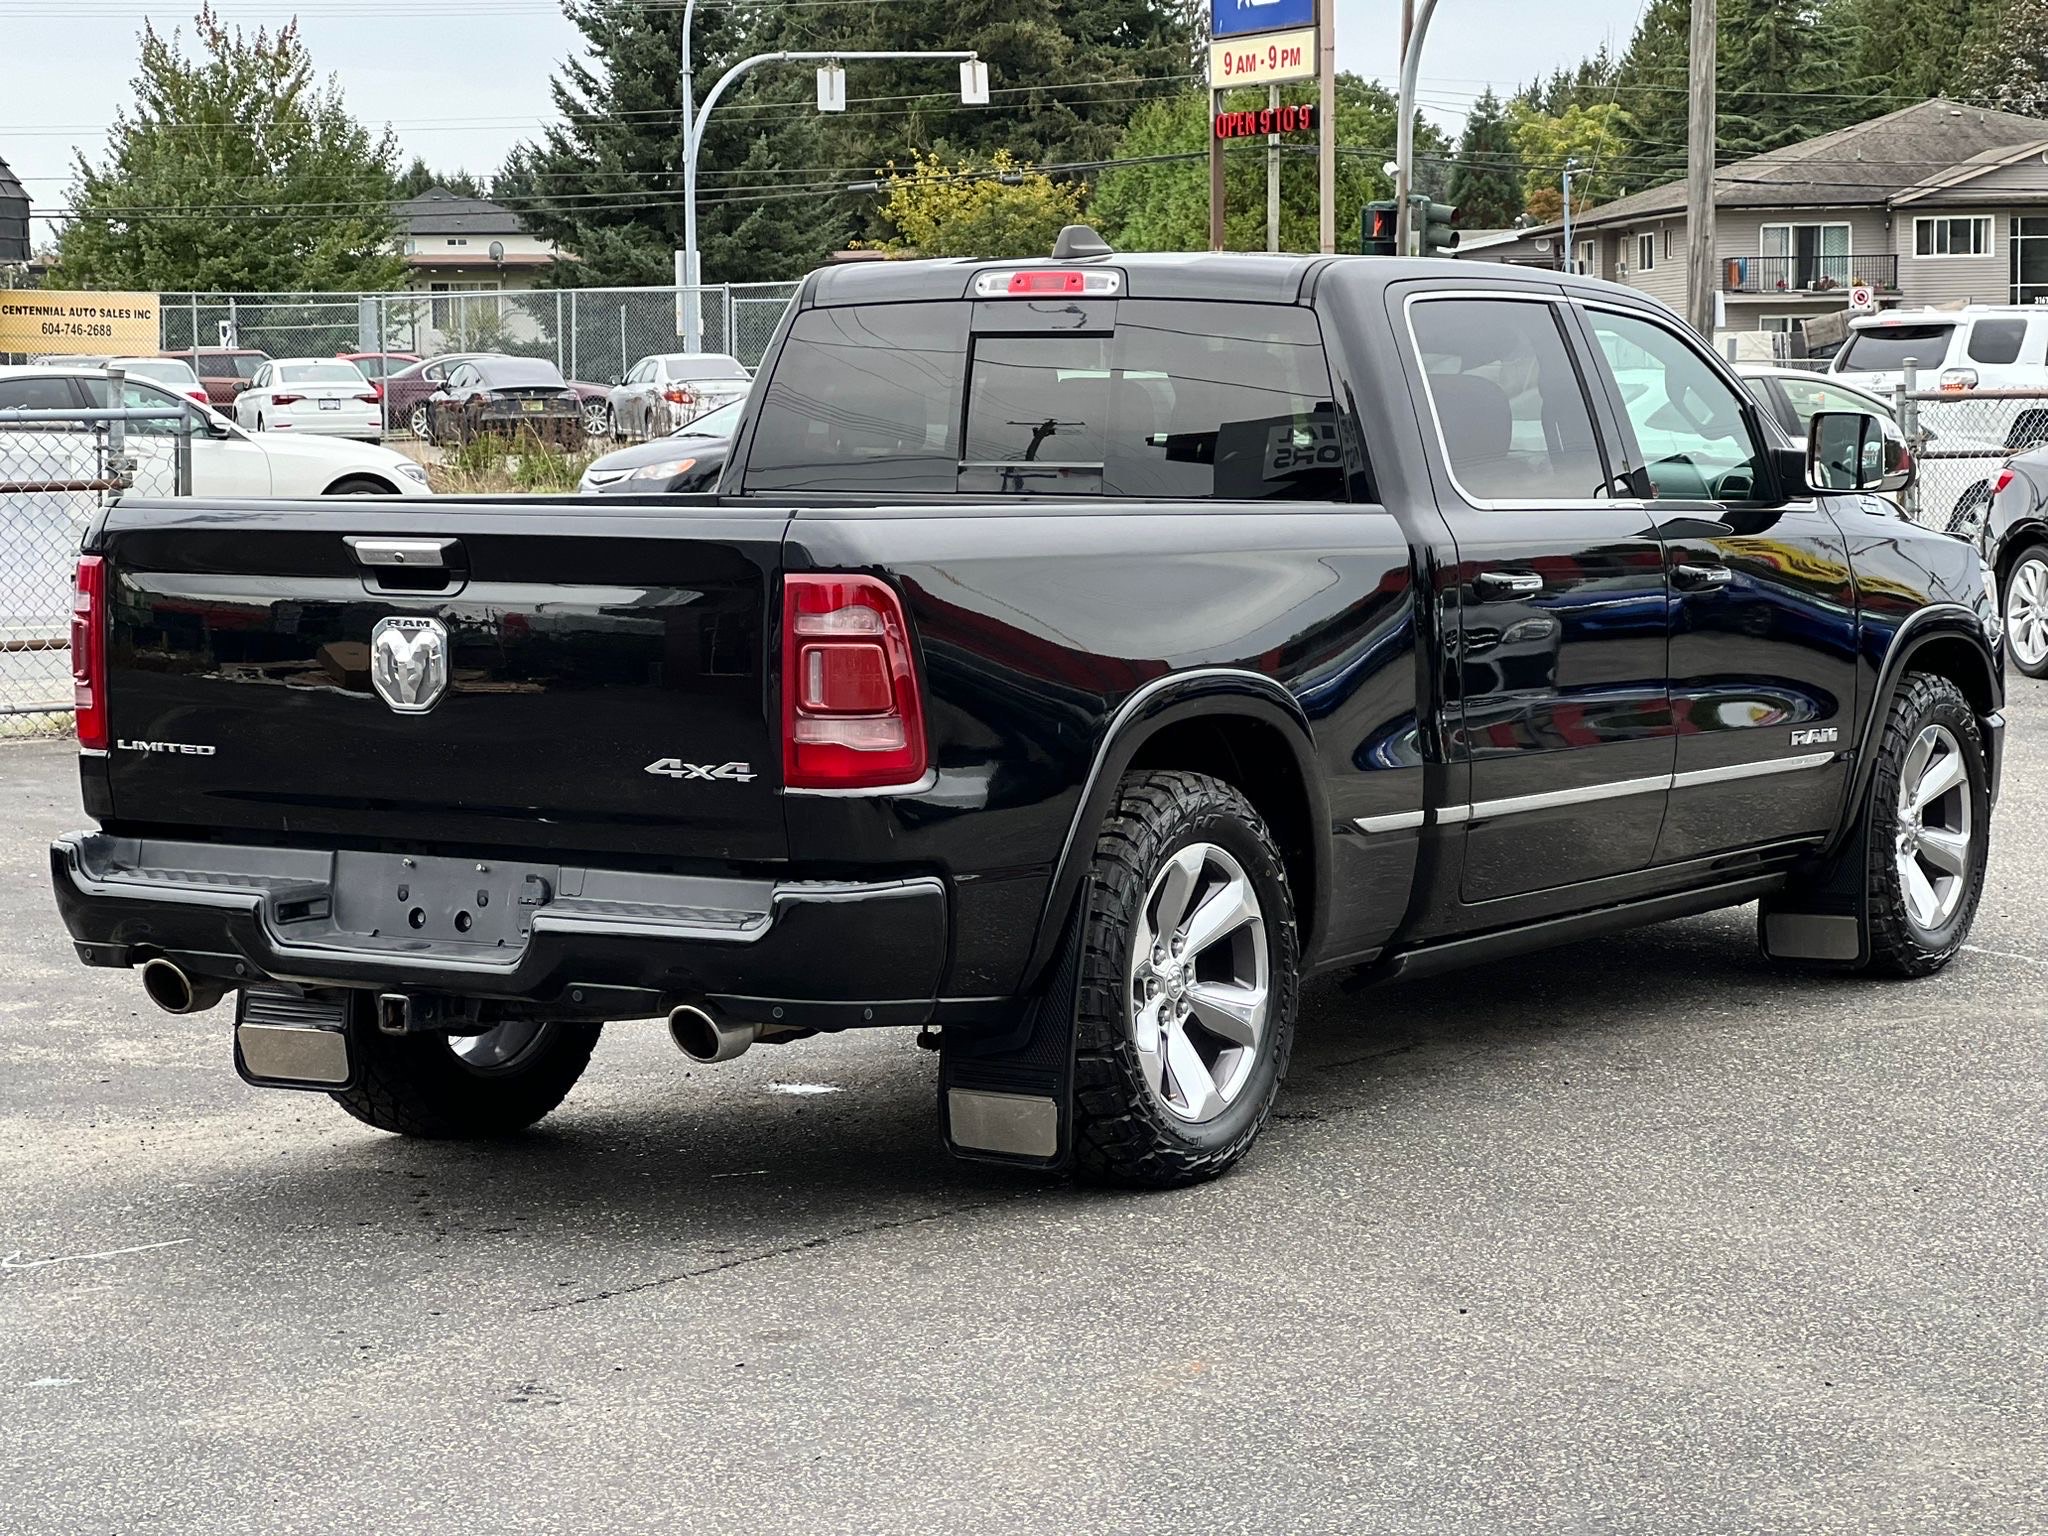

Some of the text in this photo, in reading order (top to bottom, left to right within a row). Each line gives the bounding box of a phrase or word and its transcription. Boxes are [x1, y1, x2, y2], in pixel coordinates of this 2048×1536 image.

[1224, 51, 1233, 76] 9
[1236, 53, 1256, 75] AM
[1268, 45, 1277, 70] 9
[1281, 47, 1301, 68] PM
[1215, 104, 1311, 139] OPEN 9 TO 9
[1, 304, 151, 320] CENTENNIAL AUTO SALES INC
[41, 322, 112, 337] 604-746-2688
[387, 619, 431, 628] RAM
[1791, 727, 1838, 746] RAM
[117, 739, 216, 756] LIMITED
